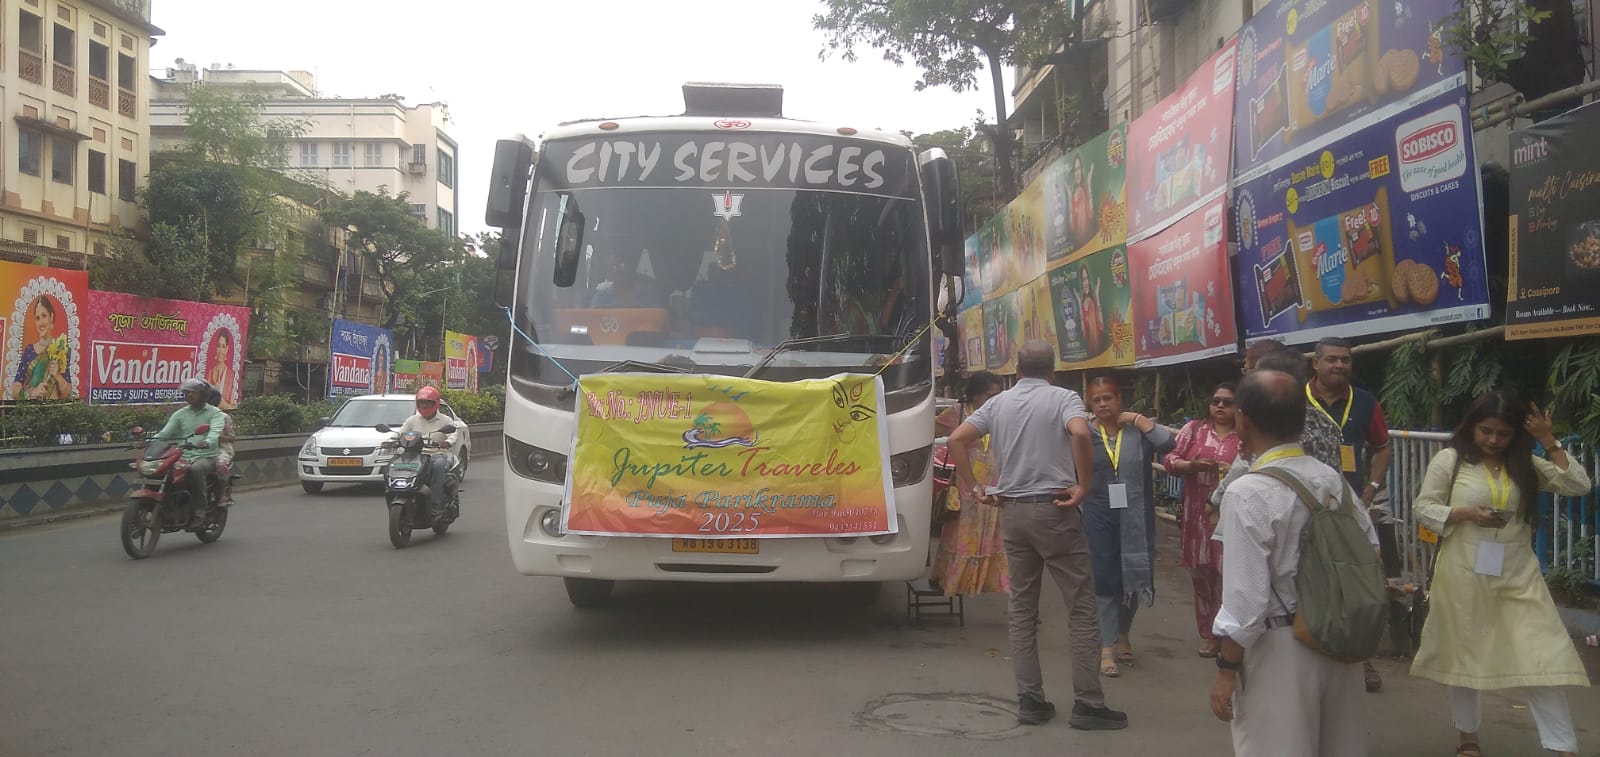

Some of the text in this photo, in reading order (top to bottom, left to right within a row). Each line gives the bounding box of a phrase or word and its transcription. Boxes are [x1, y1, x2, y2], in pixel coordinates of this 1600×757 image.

[1306, 53, 1337, 94] Marie
[1402, 126, 1455, 160] SOBISCO
[1514, 137, 1548, 165] mint
[566, 141, 886, 189] CITY SERVICES
[1369, 157, 1389, 177] FREE
[1410, 188, 1435, 202] BISCUITS
[1440, 181, 1460, 194] CAKES
[1345, 209, 1367, 230] Free!
[1316, 243, 1348, 279] Marie
[108, 312, 136, 336] পূজা
[95, 345, 193, 384] Vandana
[334, 356, 370, 386] Vandana
[92, 389, 186, 400] SAREES SUITS BEDSHEE
[611, 447, 861, 488] Jupiter Traveles
[625, 487, 836, 514] Puja Parikrama
[699, 512, 762, 532] 2025
